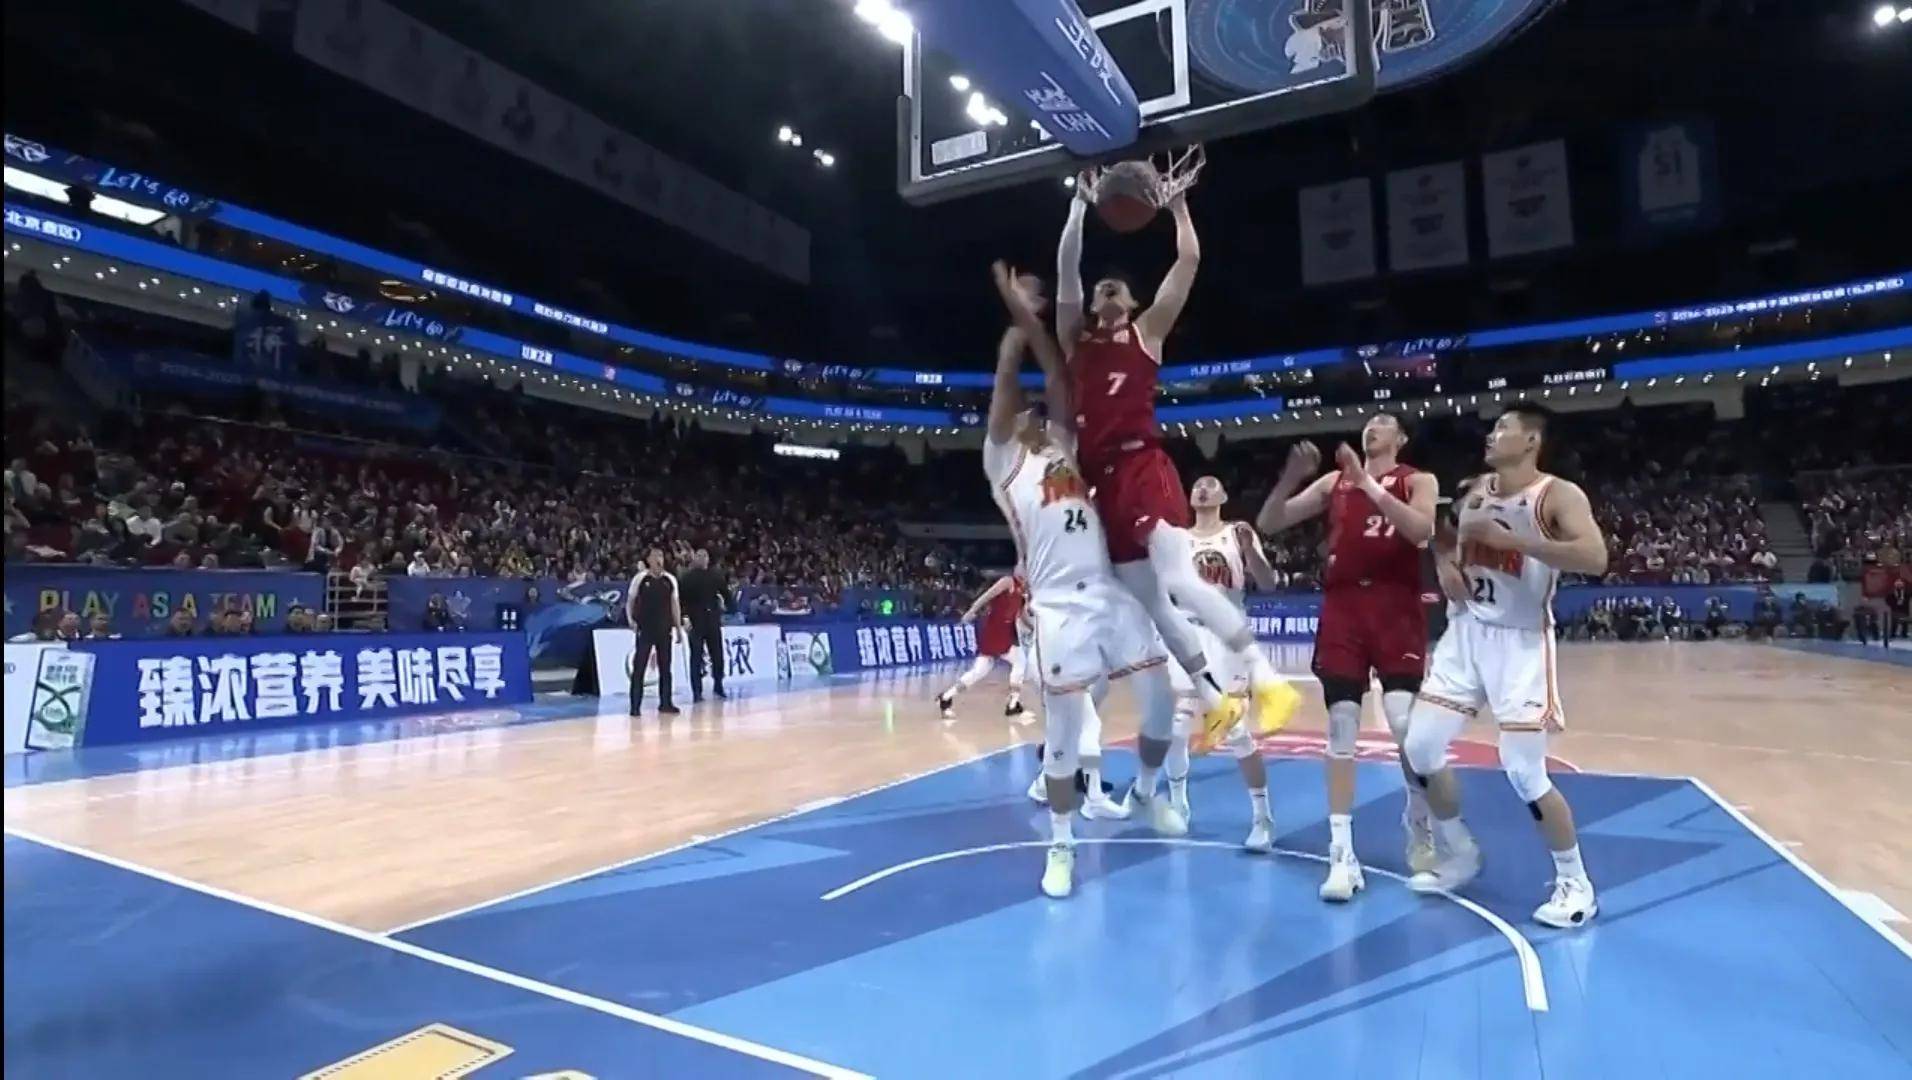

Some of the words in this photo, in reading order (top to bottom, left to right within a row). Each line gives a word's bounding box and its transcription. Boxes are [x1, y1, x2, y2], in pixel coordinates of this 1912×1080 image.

[1107, 372, 1127, 396] 7
[1064, 509, 1088, 534] 24
[1473, 577, 1496, 604] 21
[132, 592, 170, 618] AS
[182, 592, 199, 618] A
[137, 650, 346, 729] 臻浓营养
[356, 643, 506, 711] 美味尽享
